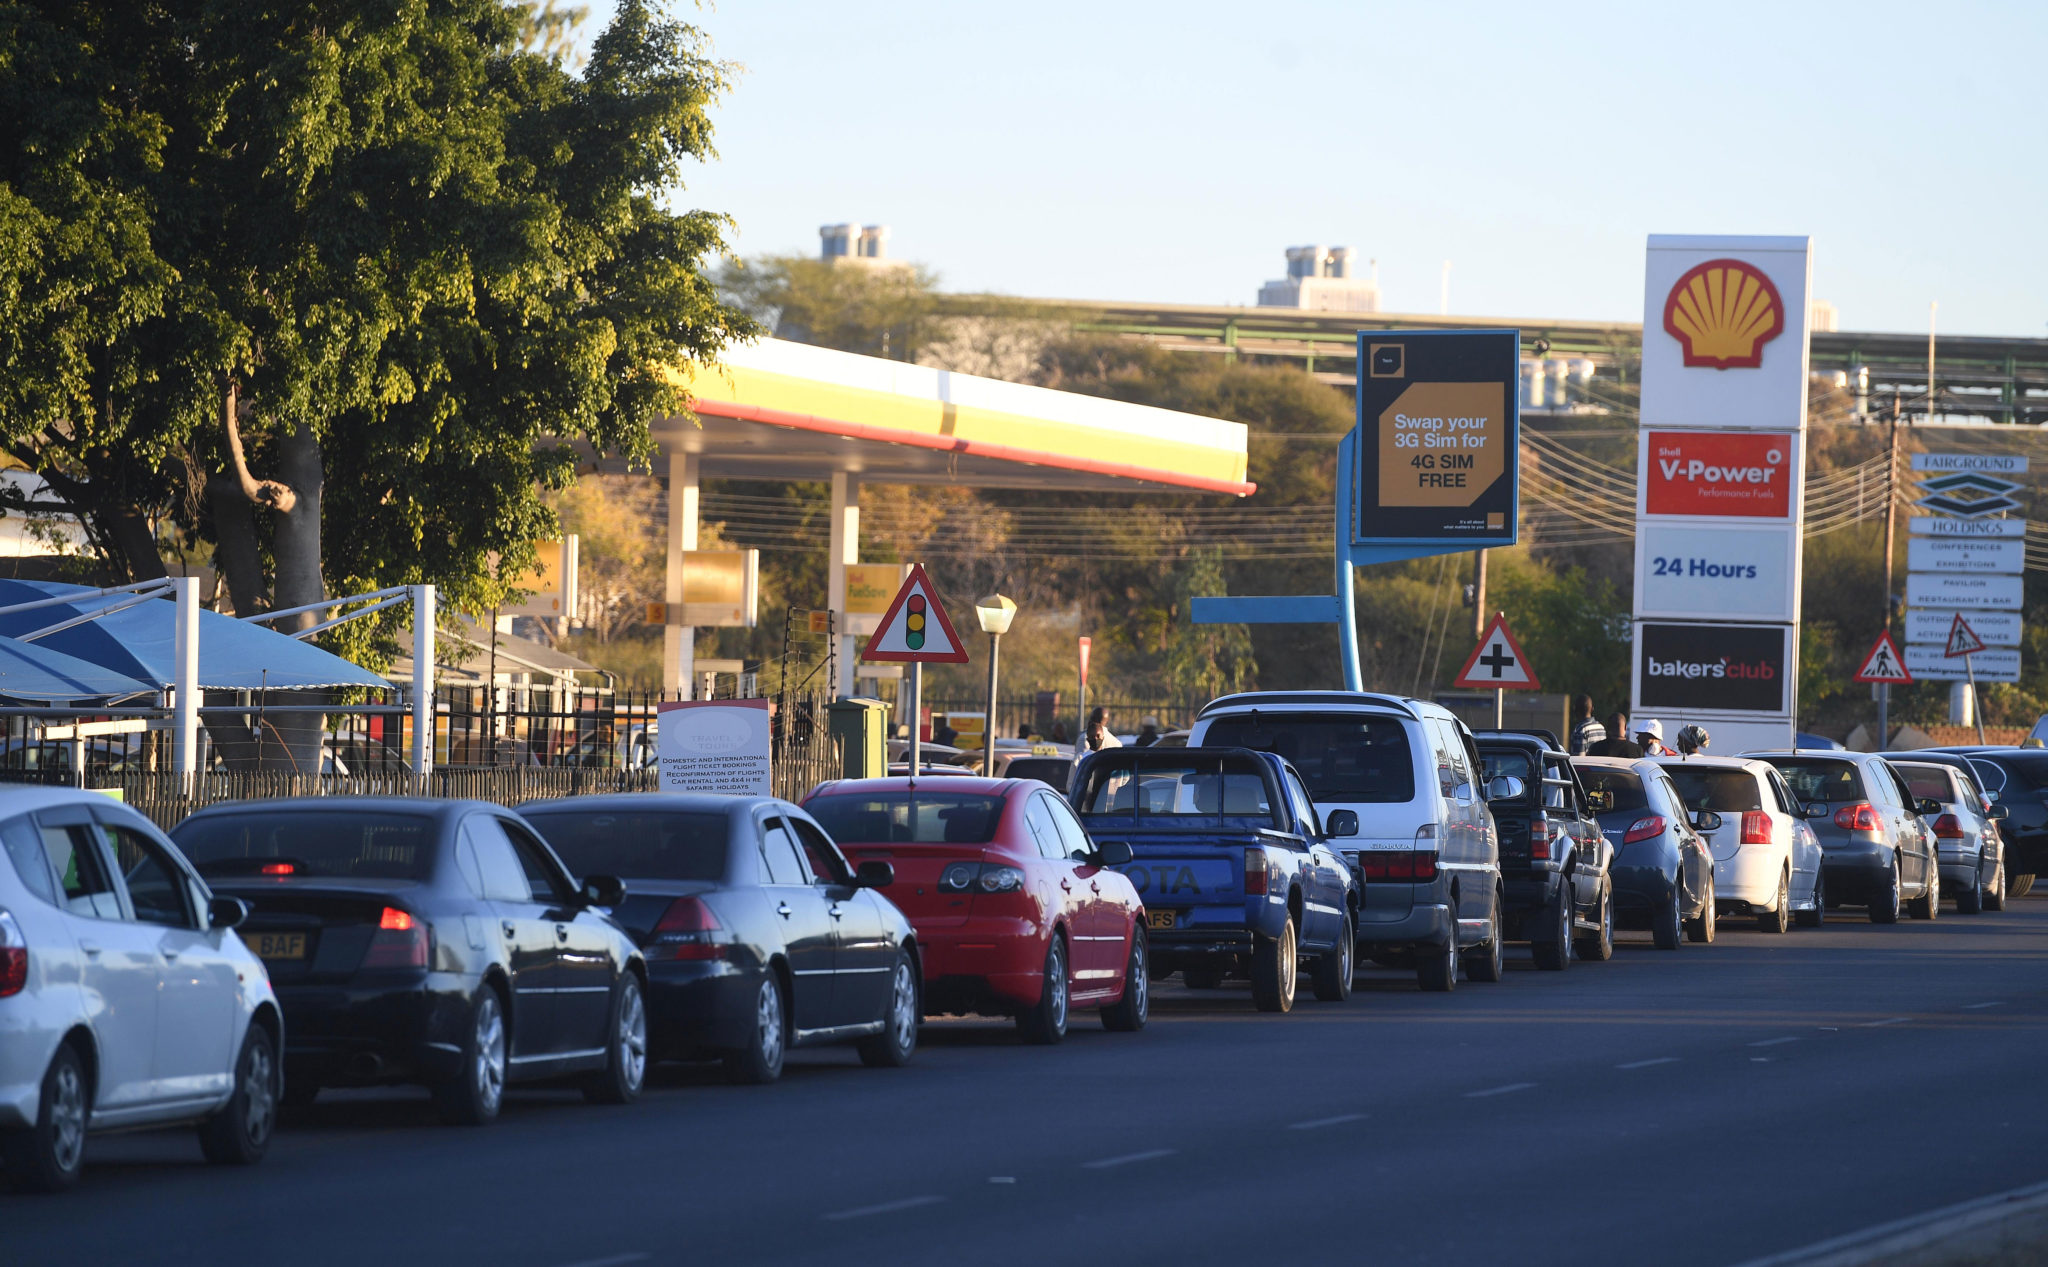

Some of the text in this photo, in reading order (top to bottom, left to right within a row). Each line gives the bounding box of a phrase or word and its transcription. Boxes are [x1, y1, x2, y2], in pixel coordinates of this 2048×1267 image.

[1394, 413, 1488, 432] Swap your
[1394, 432, 1487, 448] 3G Sim for
[1658, 447, 1681, 457] Shell
[1411, 454, 1474, 469] 4G SIM
[1923, 455, 2015, 470] FAIRGROUND
[1658, 459, 1776, 483] V-Power
[1419, 472, 1466, 488] FREE
[1698, 487, 1774, 499] Performance Fuels
[1932, 520, 2004, 535] HOLDINGS
[1930, 542, 2003, 552] CONFERENCES
[1653, 556, 1757, 579] 24 Hours
[1943, 579, 1987, 587] PAVILION
[1918, 595, 1981, 604] RESTAURANT
[1117, 866, 1201, 894] OTA
